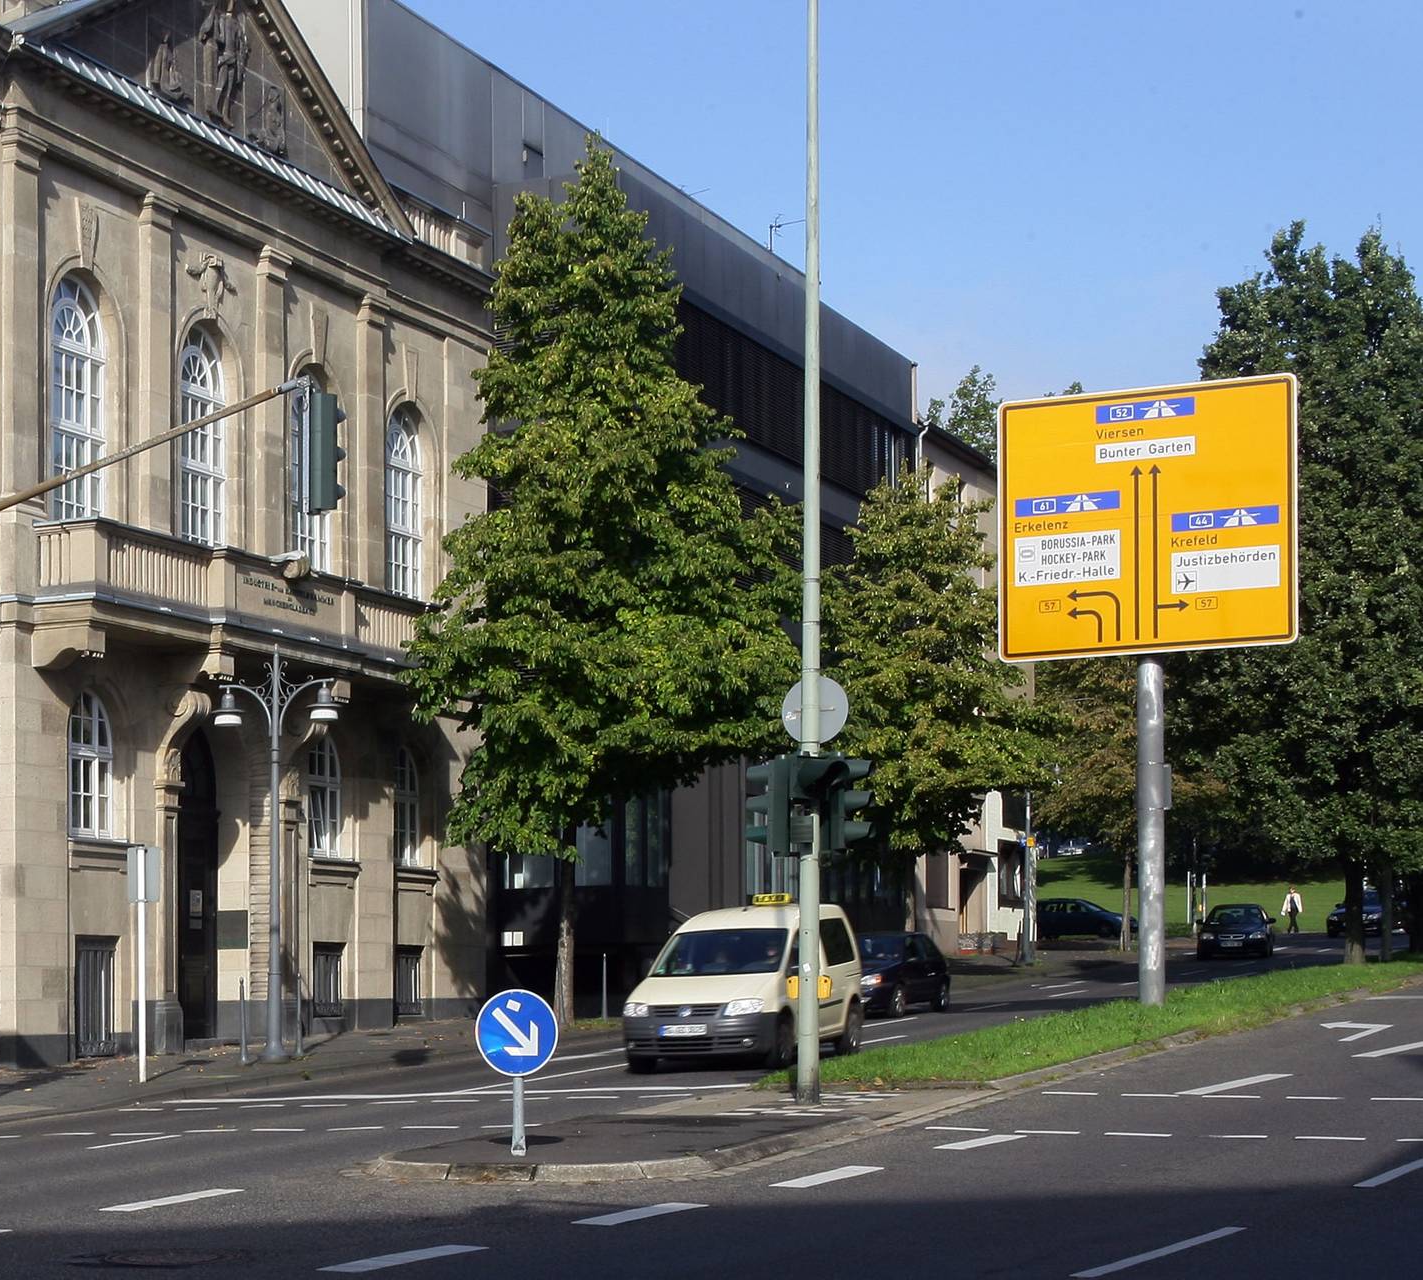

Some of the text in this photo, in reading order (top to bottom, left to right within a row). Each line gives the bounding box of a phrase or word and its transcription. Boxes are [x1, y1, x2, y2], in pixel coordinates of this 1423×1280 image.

[1115, 408, 1128, 417] 52
[1096, 427, 1144, 439] Viersen
[1099, 442, 1192, 459] Bunter Garten
[1039, 502, 1049, 511] 61
[1014, 520, 1069, 533] Erkelenz
[1195, 516, 1208, 525] 44
[1041, 533, 1116, 551] BORUSSIA-PARK
[1171, 534, 1218, 547] Krefeld
[1041, 550, 1106, 566] HOCKEY-PARK
[1176, 550, 1276, 568] Justizbehörden
[1018, 565, 1115, 583] K.-Friedr.-Halle
[1044, 602, 1055, 611] 57
[1201, 599, 1212, 608] 57
